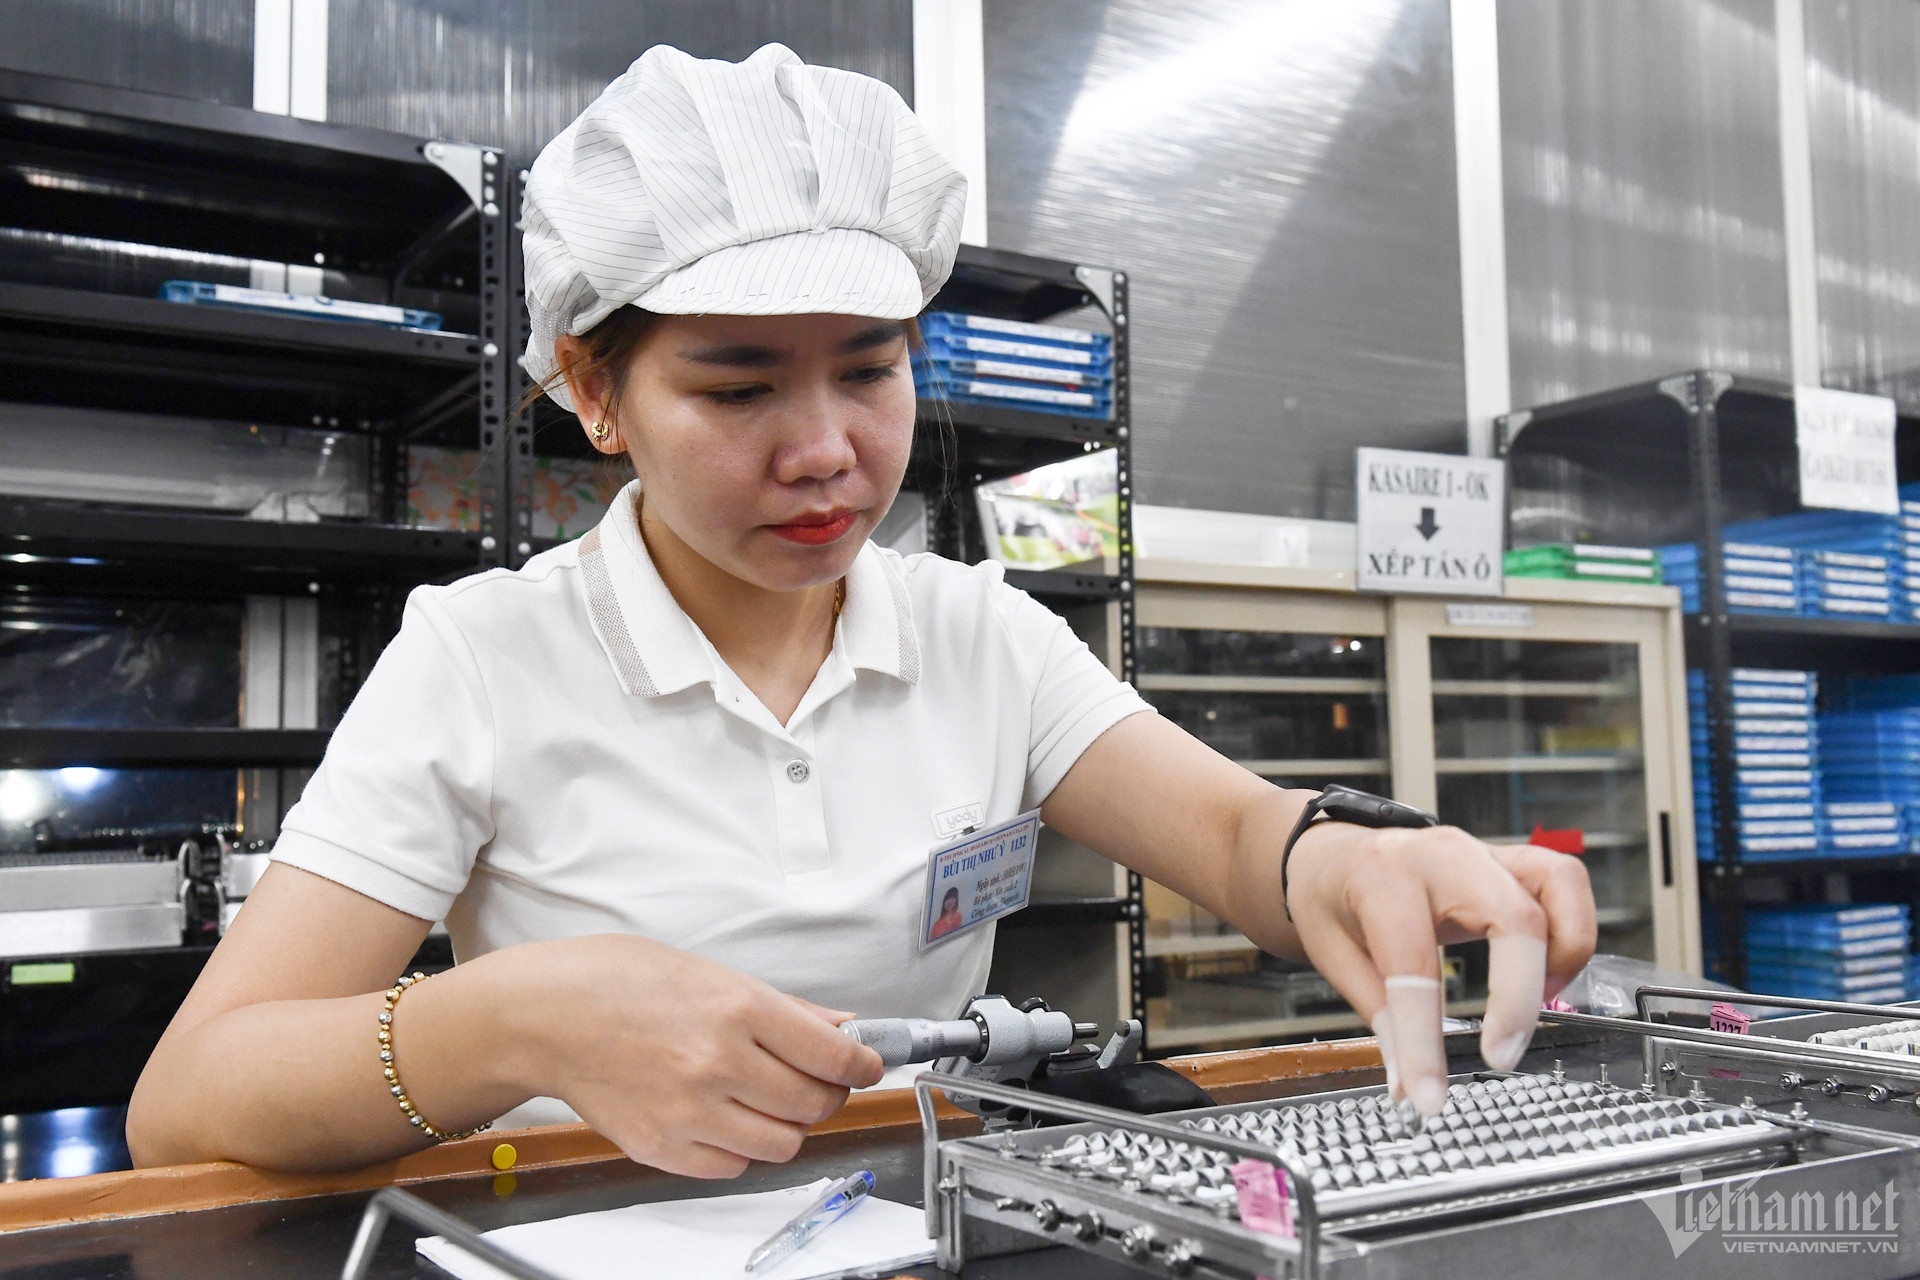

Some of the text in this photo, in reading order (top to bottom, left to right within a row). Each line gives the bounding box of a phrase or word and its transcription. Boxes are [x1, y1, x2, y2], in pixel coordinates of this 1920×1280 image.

[1466, 471, 1489, 501] OK
[945, 808, 978, 829] yody
[943, 859, 960, 879] BÙI
[961, 855, 977, 871] THỊ
[977, 844, 999, 865] NHƯ
[1011, 835, 1027, 852] 1132
